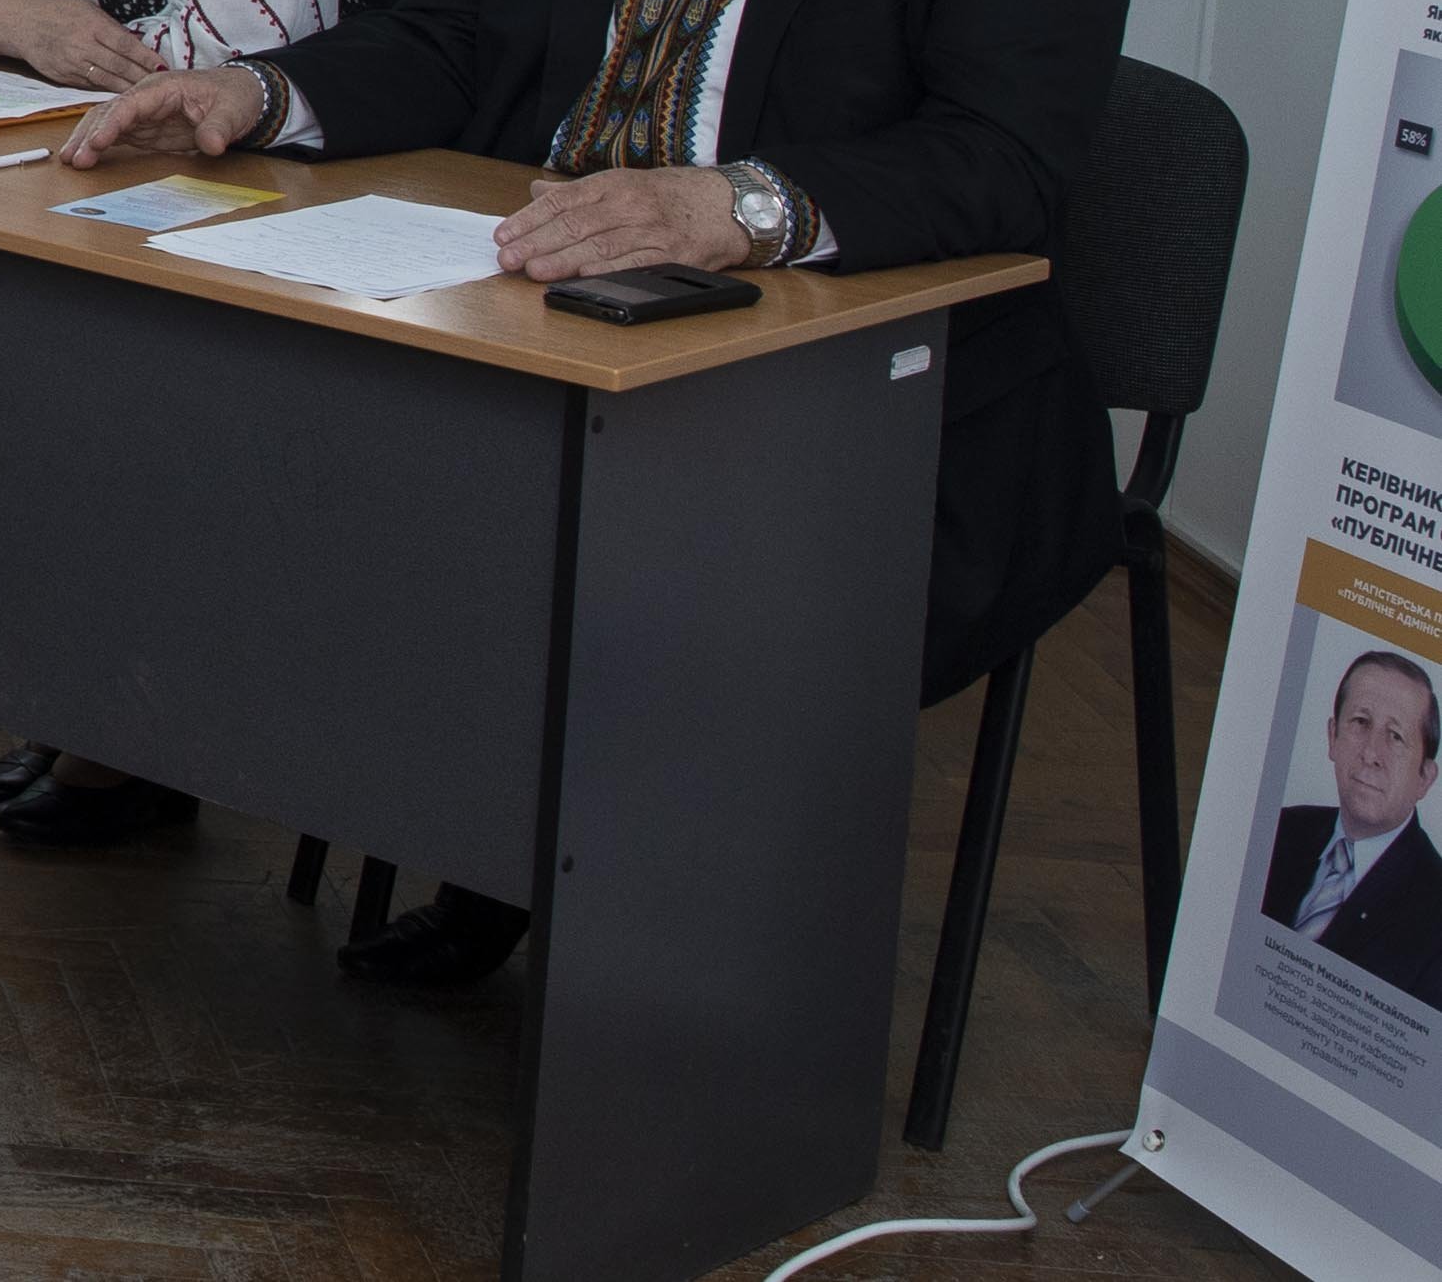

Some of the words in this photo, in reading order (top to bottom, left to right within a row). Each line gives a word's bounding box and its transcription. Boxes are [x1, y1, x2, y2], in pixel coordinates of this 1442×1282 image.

[1400, 127, 1428, 148] 58%
[1335, 484, 1437, 540] ПРОГРАМ
[1353, 578, 1432, 620] МАГІСТЕРСЬКА
[1264, 935, 1315, 971] Шкільняк
[1317, 963, 1362, 998] Михайло
[1364, 991, 1431, 1036] Михайлович
[1277, 961, 1314, 987] доктор
[1264, 1000, 1331, 1048] менеджменту
[1311, 995, 1372, 1036] заслужений
[1374, 1031, 1427, 1068] економіст
[1311, 1011, 1360, 1046] завідувач
[1360, 1041, 1407, 1074] кафедри
